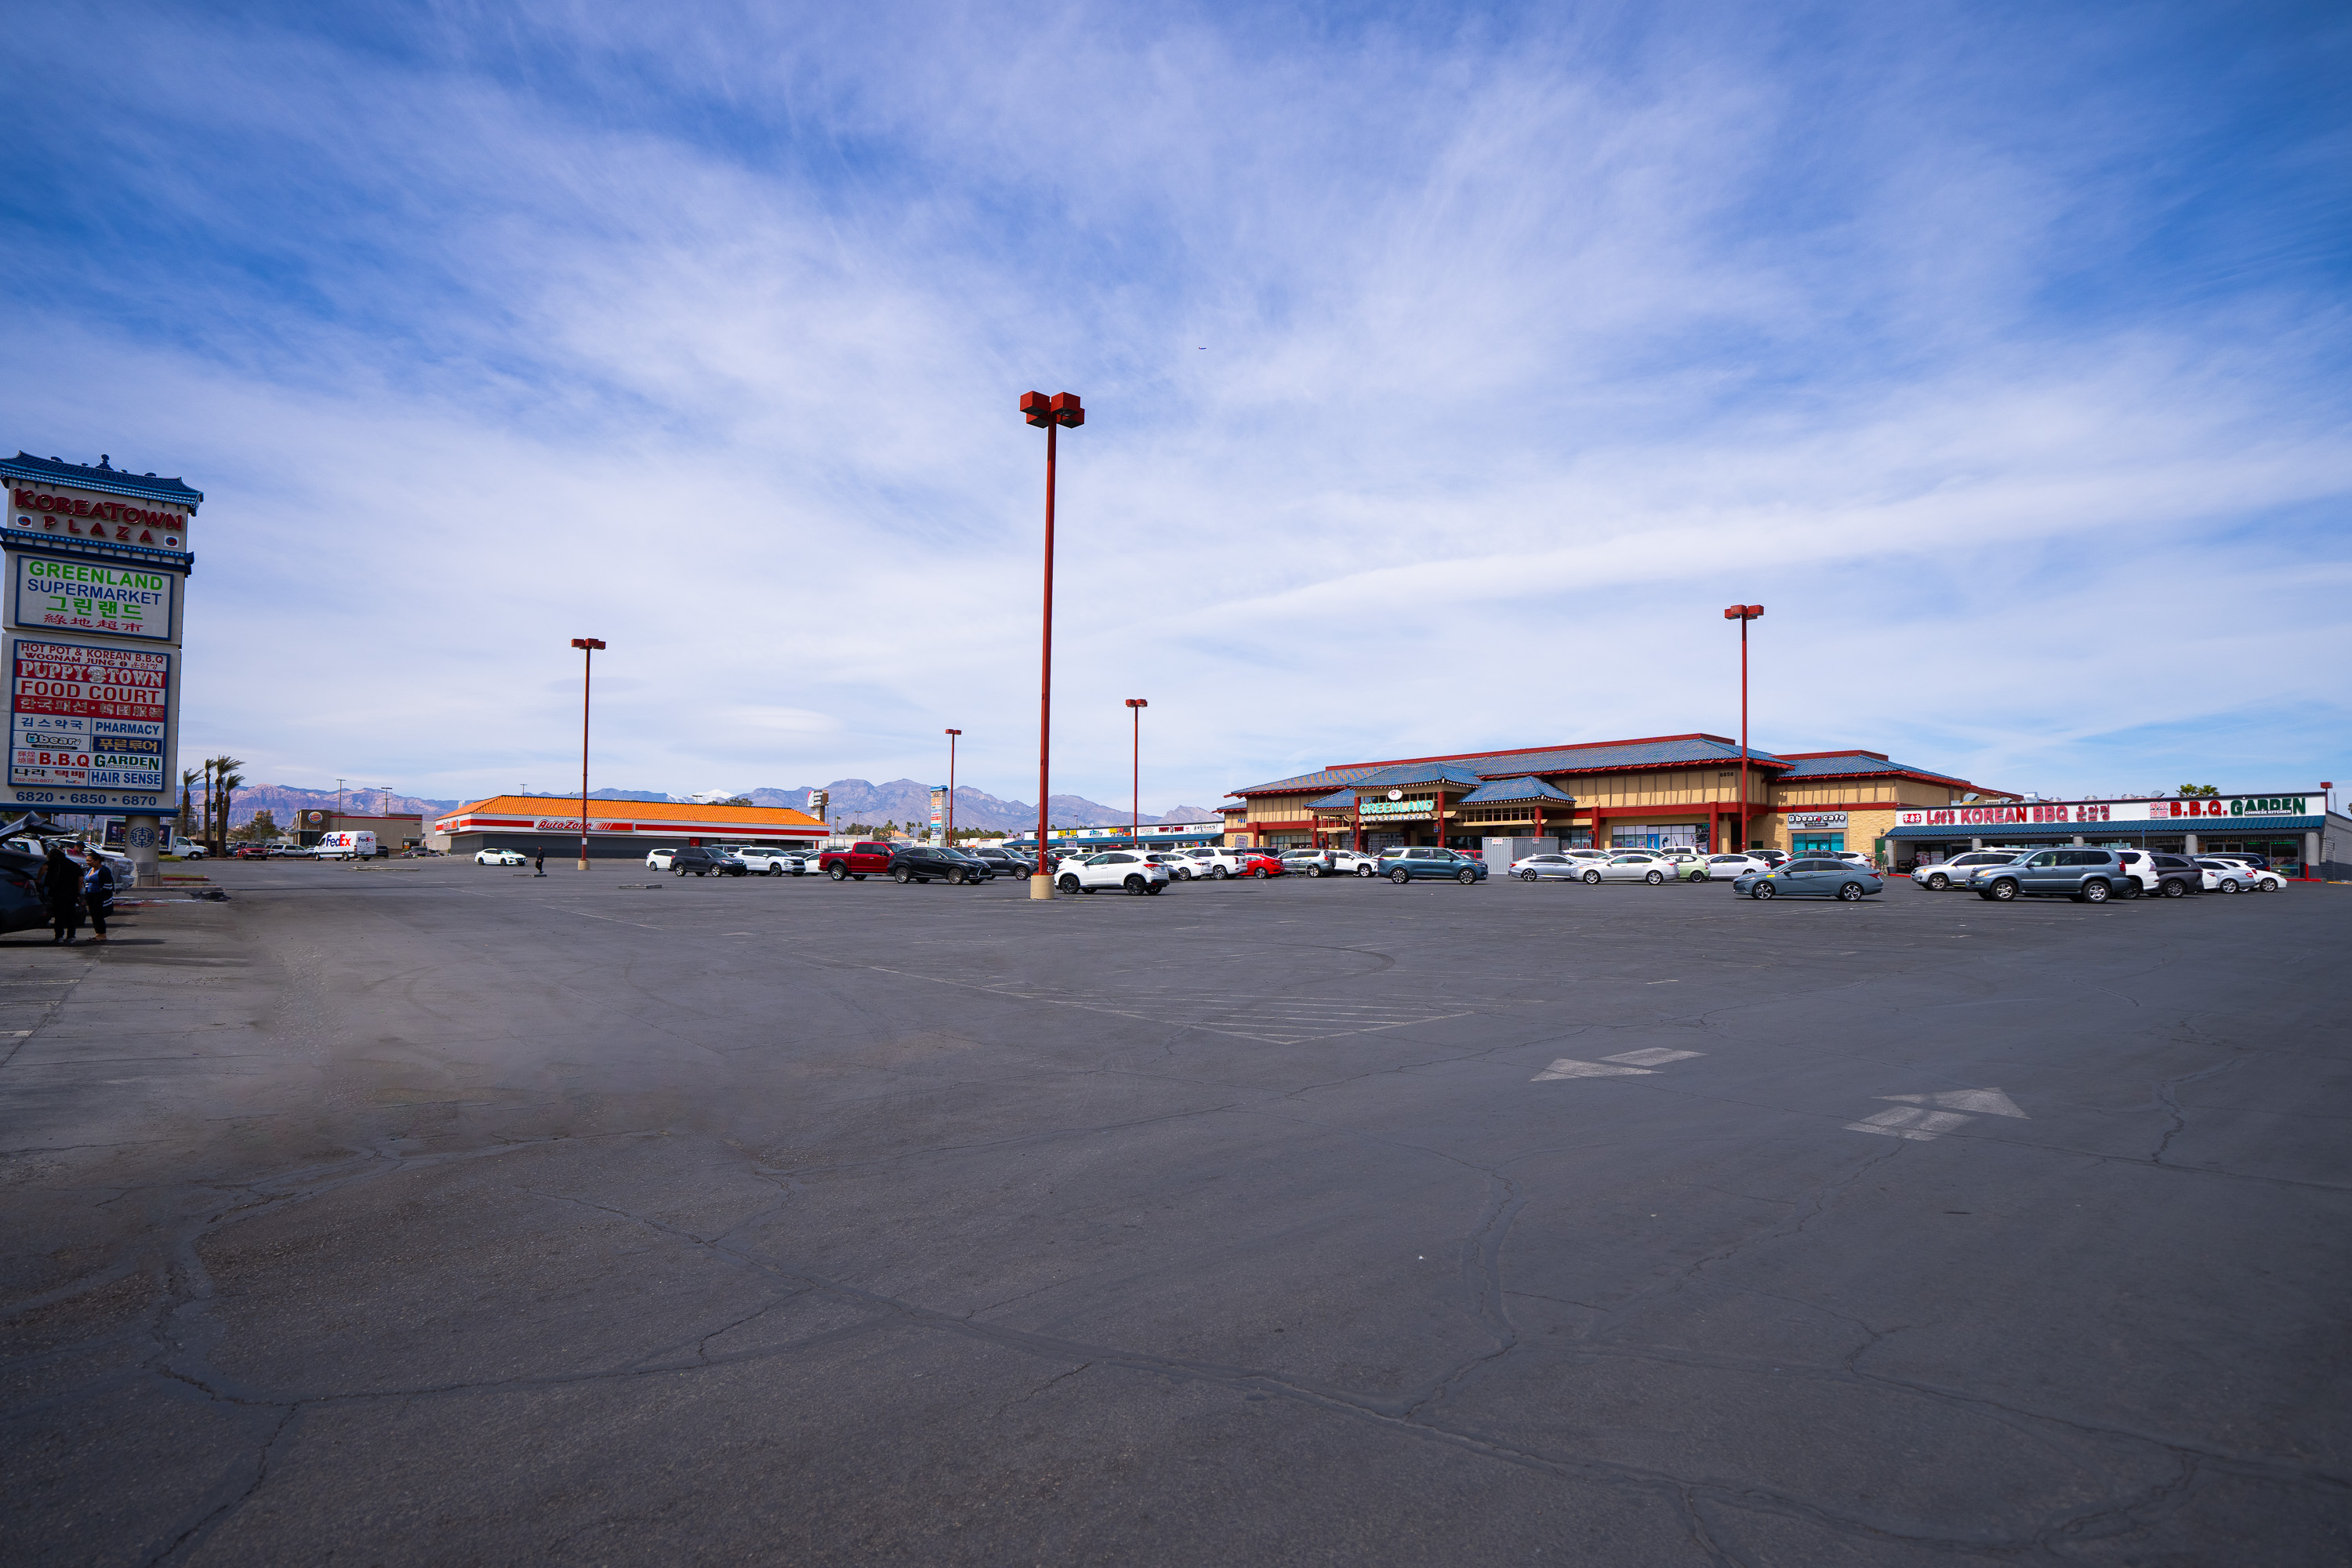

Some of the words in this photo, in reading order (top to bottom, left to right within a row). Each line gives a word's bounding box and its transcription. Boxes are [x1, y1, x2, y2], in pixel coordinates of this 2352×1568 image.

[14, 488, 183, 530] KOREATOWN
[44, 515, 154, 543] PLAZA
[29, 561, 163, 590] GREENLAND
[27, 579, 162, 605] SUPERMARKET
[46, 596, 143, 620] 그린랜드
[44, 614, 143, 632] 綠地超市
[21, 643, 45, 652] HOT
[49, 646, 71, 655] POT
[74, 648, 82, 657] &
[87, 649, 132, 661] KOREAN
[135, 654, 164, 664] B.B.Q
[25, 652, 81, 663] WOONAM
[85, 658, 115, 666] JUNG
[20, 661, 87, 681] PUPPY
[107, 669, 163, 688] TOWN
[20, 681, 81, 698] FOOD
[89, 685, 160, 704] COURT
[20, 697, 88, 714] 한국패션
[21, 717, 84, 730] 김스약국
[96, 721, 160, 735] PHARMACY
[99, 739, 158, 753] 푸른투어
[39, 753, 89, 768] B.B.Q
[94, 754, 159, 771] GARDEN
[15, 768, 47, 777] 나라
[55, 770, 85, 779] 택배
[92, 771, 120, 783] HAIR
[123, 772, 161, 785] SENSE
[16, 791, 54, 803] 6820
[70, 793, 107, 804] 6850
[122, 795, 157, 806] 6870
[1359, 800, 1434, 815] GREENLAND
[2170, 800, 2227, 816] B.B.Q.
[2230, 797, 2306, 815] GARDEN
[1927, 809, 1955, 824] Lee's
[1961, 806, 2027, 824] KOREAN
[2033, 805, 2068, 822] BBQ
[2076, 804, 2111, 822] 운암정
[537, 820, 592, 830] AutoZone
[326, 834, 351, 847] FedEx
